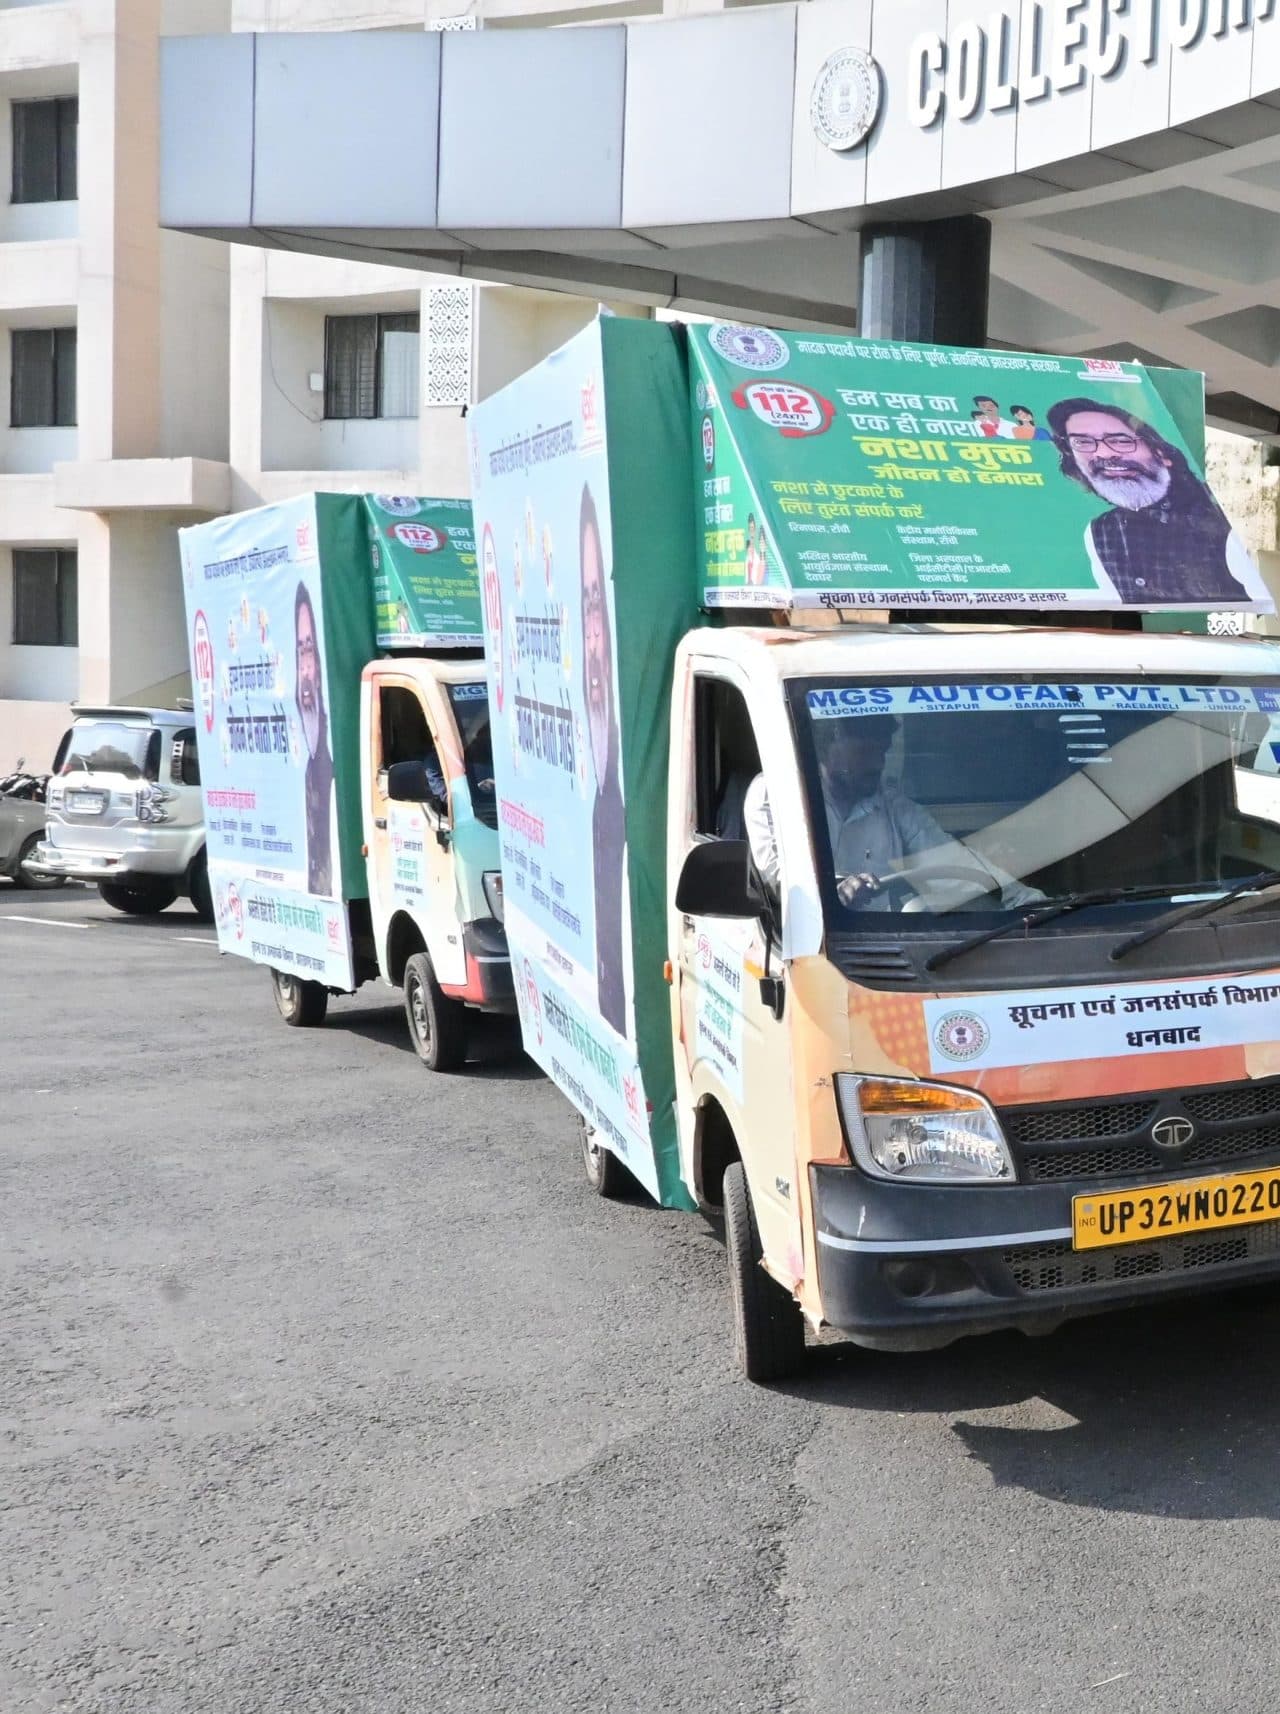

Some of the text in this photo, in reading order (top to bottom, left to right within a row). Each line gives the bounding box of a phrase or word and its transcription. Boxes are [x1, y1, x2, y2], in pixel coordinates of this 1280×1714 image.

[795, 341, 825, 354] मादक
[855, 345, 871, 358] पर
[870, 343, 890, 359] रोक
[889, 345, 902, 360] के
[901, 346, 923, 362] लिए
[752, 392, 813, 414] 112
[837, 388, 958, 413] हम सब का
[847, 412, 981, 438] एक ही नारा
[852, 436, 1033, 471] नशा मुक्त
[867, 463, 1045, 486] जीवन हो हमारा
[770, 480, 904, 500] नशा से छुटकारे के
[778, 498, 925, 519] लिए तुरंत संपर्क करें
[398, 529, 434, 542] 112
[817, 592, 856, 608] सूचना
[857, 590, 875, 604] एवं
[877, 590, 931, 605] जनसंपर्क
[932, 589, 973, 605] विभाग,
[1028, 592, 1069, 604] सरकार
[808, 688, 893, 708] MGS
[1095, 686, 1169, 703] PVT.
[1180, 687, 1251, 703] LTD.
[822, 705, 891, 716] LUCKNOW
[926, 703, 981, 711] SITAPUR
[1015, 702, 1085, 710] BARABANKI
[1116, 702, 1180, 710] RAEBARELI
[1007, 1003, 1075, 1029] सूचना
[1082, 996, 1116, 1017] एवं
[1121, 988, 1218, 1014] जनसंपर्क
[1126, 1025, 1201, 1048] धनबाद
[1078, 1217, 1097, 1227] IND
